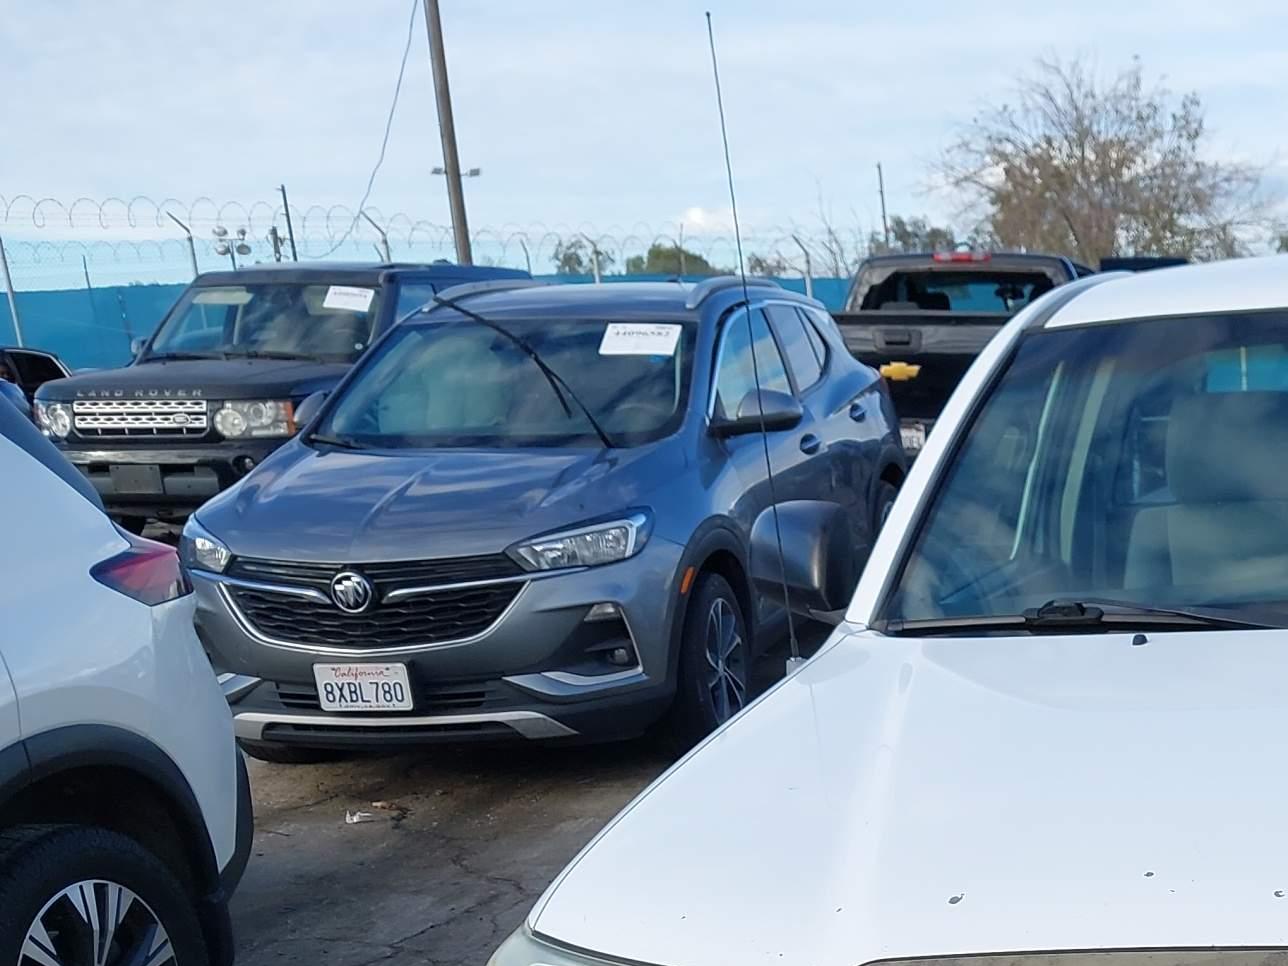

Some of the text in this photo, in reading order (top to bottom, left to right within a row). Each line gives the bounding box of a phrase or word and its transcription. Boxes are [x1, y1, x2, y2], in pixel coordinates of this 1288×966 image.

[77, 389, 202, 397] LAND ROVER
[334, 667, 390, 680] California
[324, 682, 405, 703] 8XBL780
